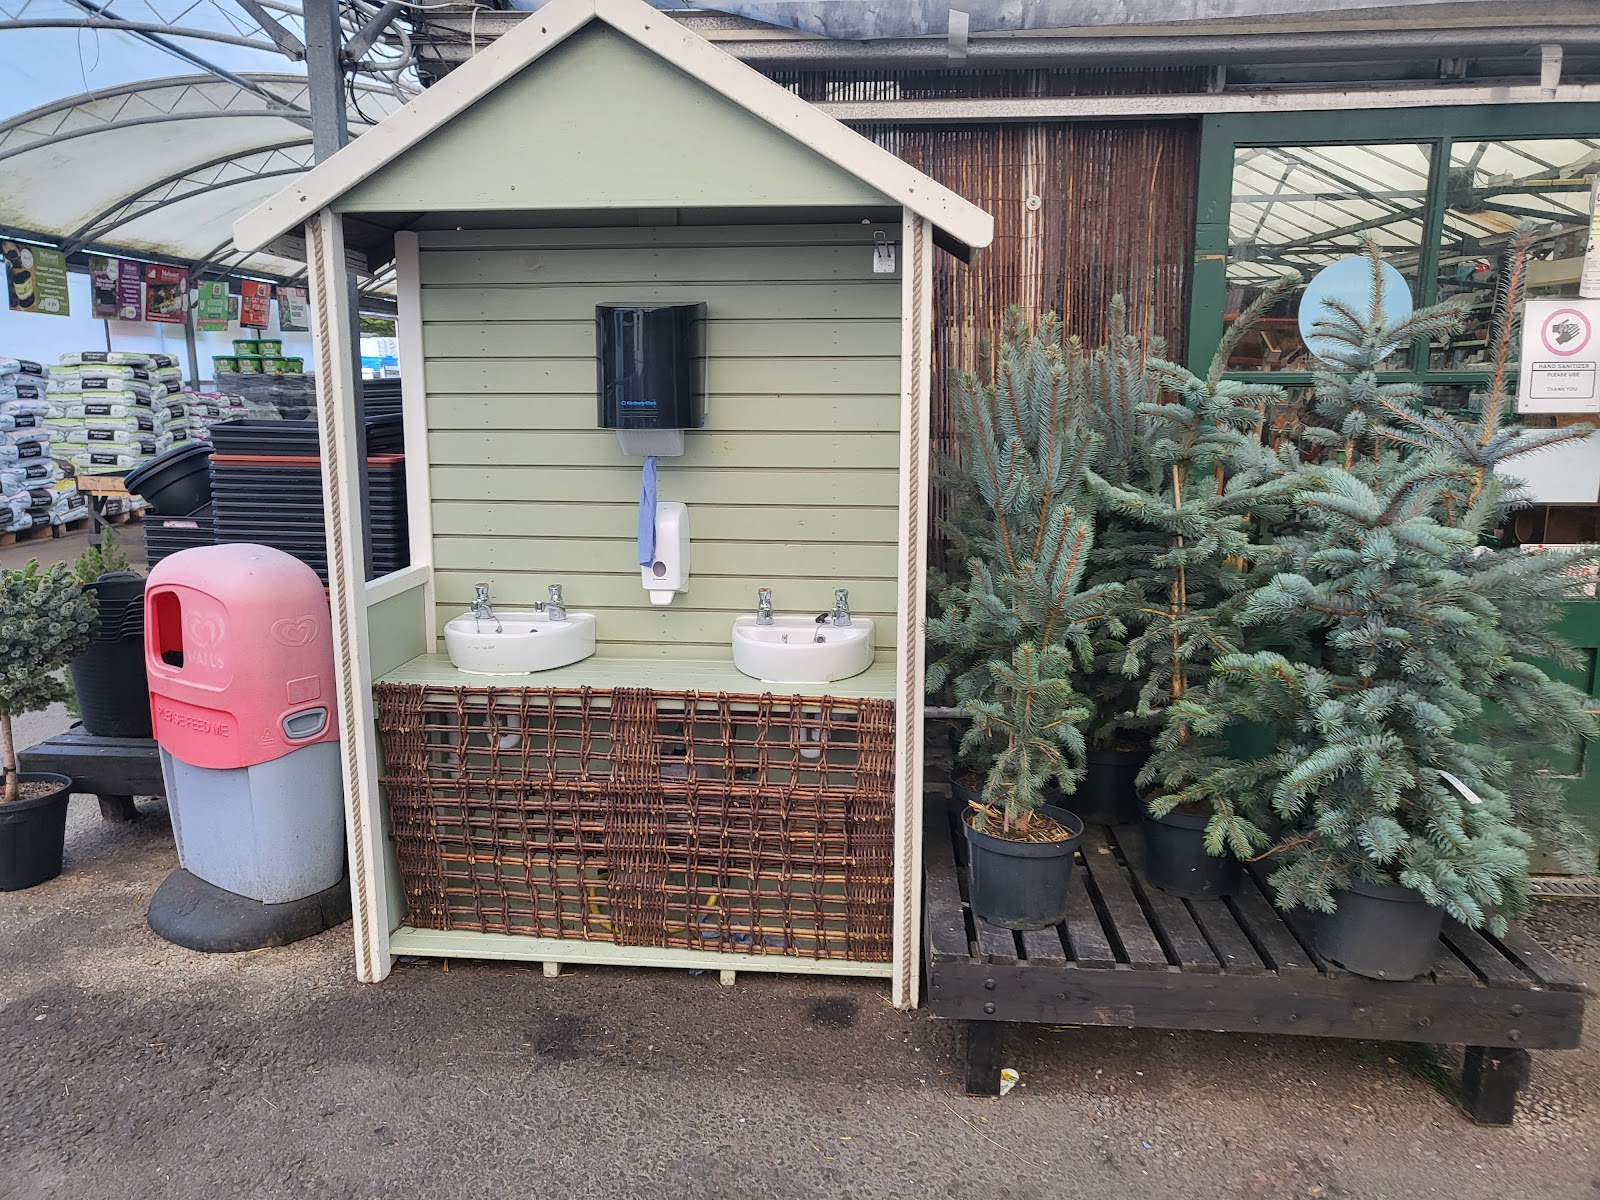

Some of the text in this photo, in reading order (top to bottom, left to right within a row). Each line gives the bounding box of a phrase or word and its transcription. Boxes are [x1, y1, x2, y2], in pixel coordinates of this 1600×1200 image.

[158, 706, 229, 738] PLEASE FEED ME
